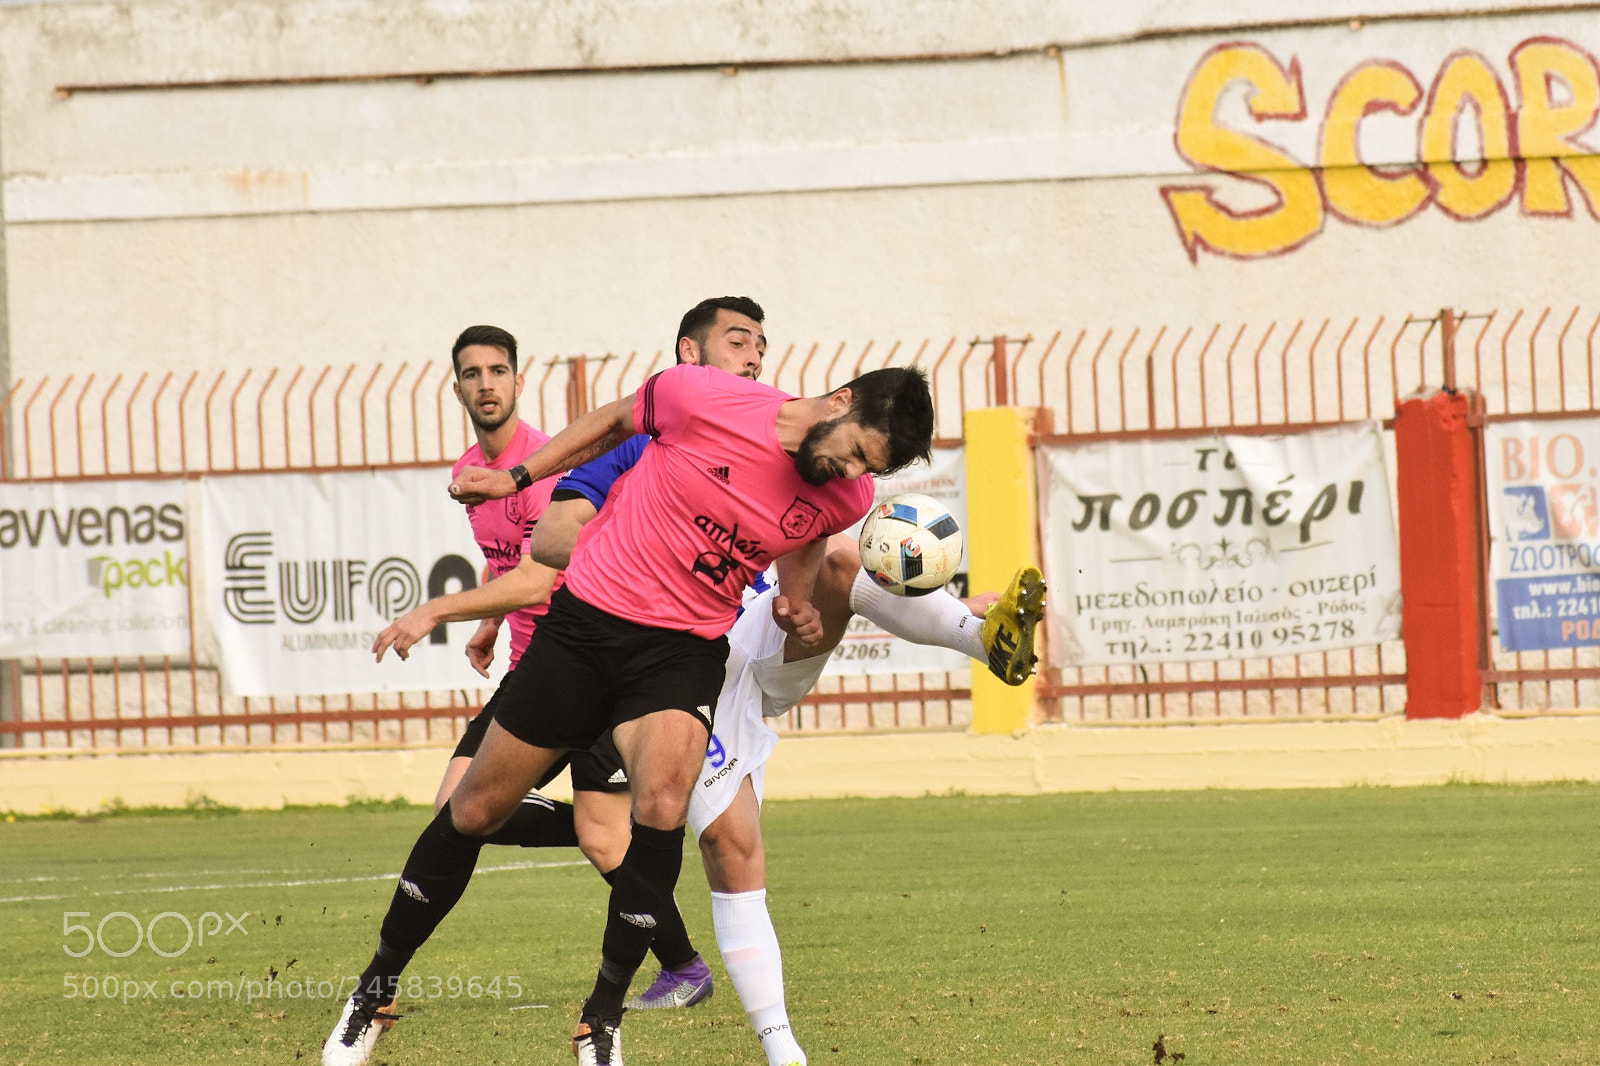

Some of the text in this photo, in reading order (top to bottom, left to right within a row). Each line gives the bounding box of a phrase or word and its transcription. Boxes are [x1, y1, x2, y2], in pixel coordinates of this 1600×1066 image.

[1071, 475, 1365, 543] ποσπέρι
[0, 503, 184, 549] avvenas
[104, 551, 188, 598] pack
[1289, 565, 1377, 596] ουζερί
[1557, 597, 1600, 618] 2241
[1184, 629, 1263, 652] 22410
[1272, 619, 1355, 646] 95278
[704, 757, 738, 788] GIVOVA
